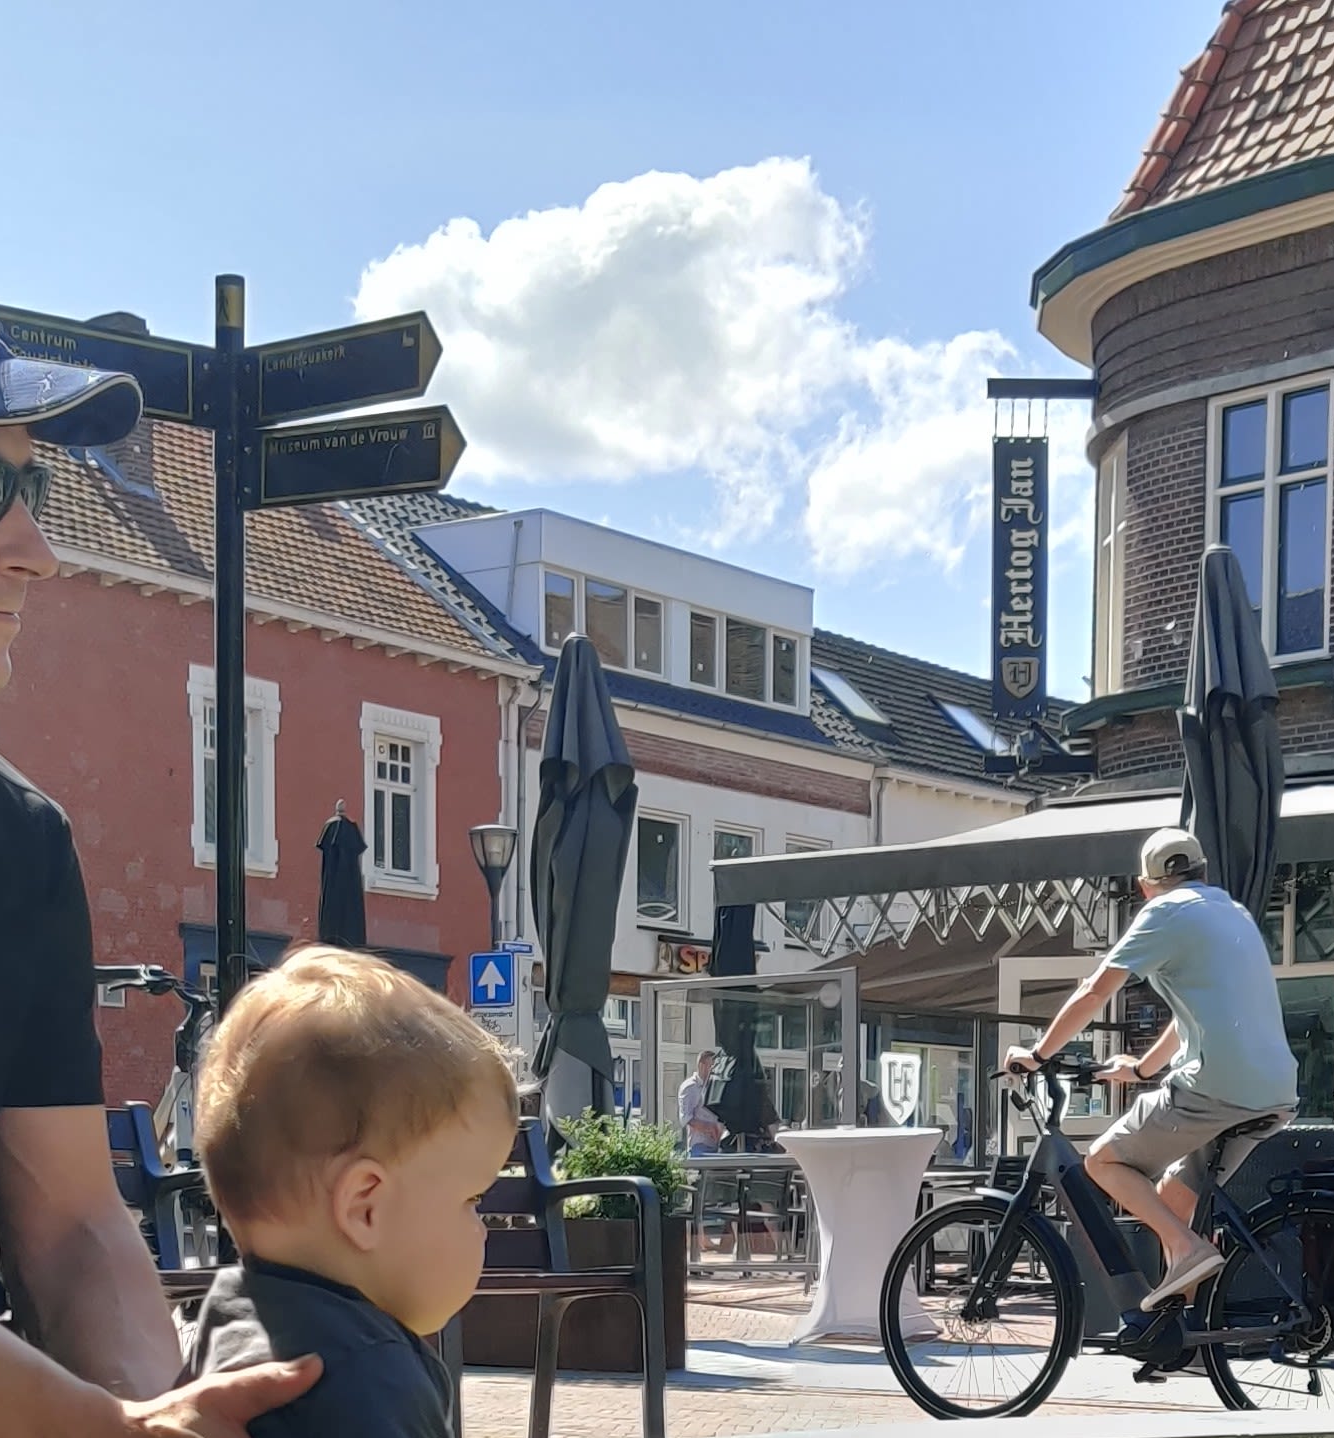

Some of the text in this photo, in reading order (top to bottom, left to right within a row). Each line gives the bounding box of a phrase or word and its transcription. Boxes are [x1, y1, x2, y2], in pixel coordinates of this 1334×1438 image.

[10, 325, 78, 351] Centrum
[269, 427, 408, 455] Museum van de Vrouw
[1000, 456, 1044, 648] Hertog Jan
